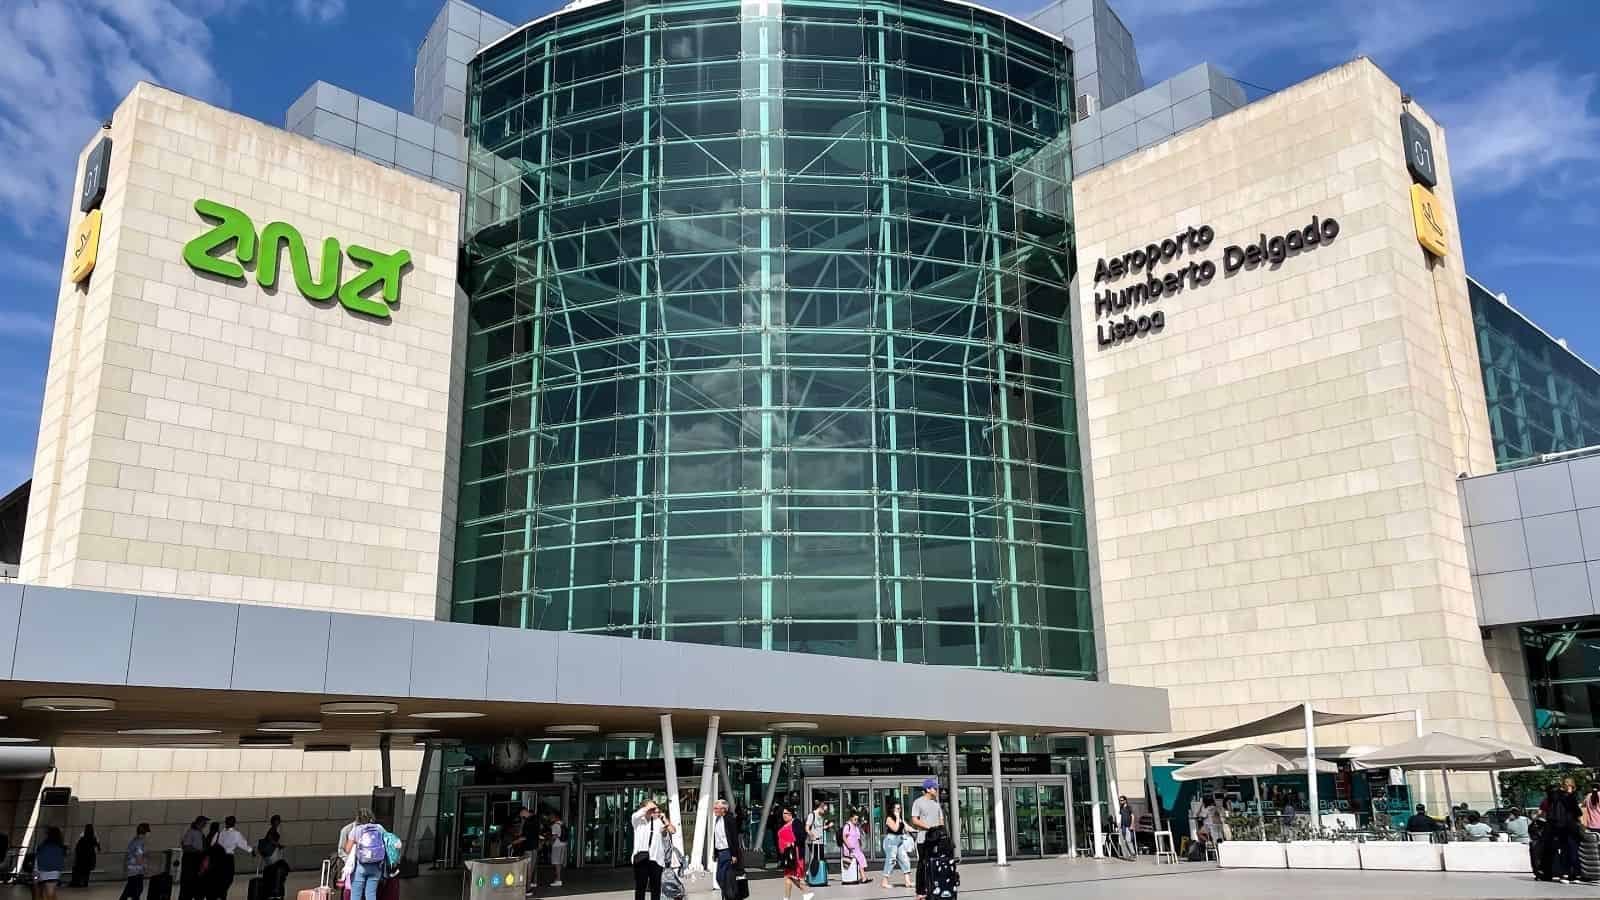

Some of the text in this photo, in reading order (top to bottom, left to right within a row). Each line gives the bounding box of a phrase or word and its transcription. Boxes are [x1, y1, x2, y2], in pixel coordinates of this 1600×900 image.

[1415, 140, 1432, 173] 01
[1094, 224, 1214, 288] Aeroporto
[1095, 215, 1340, 320] Humberto Delgado
[1097, 310, 1165, 351] Lisboa
